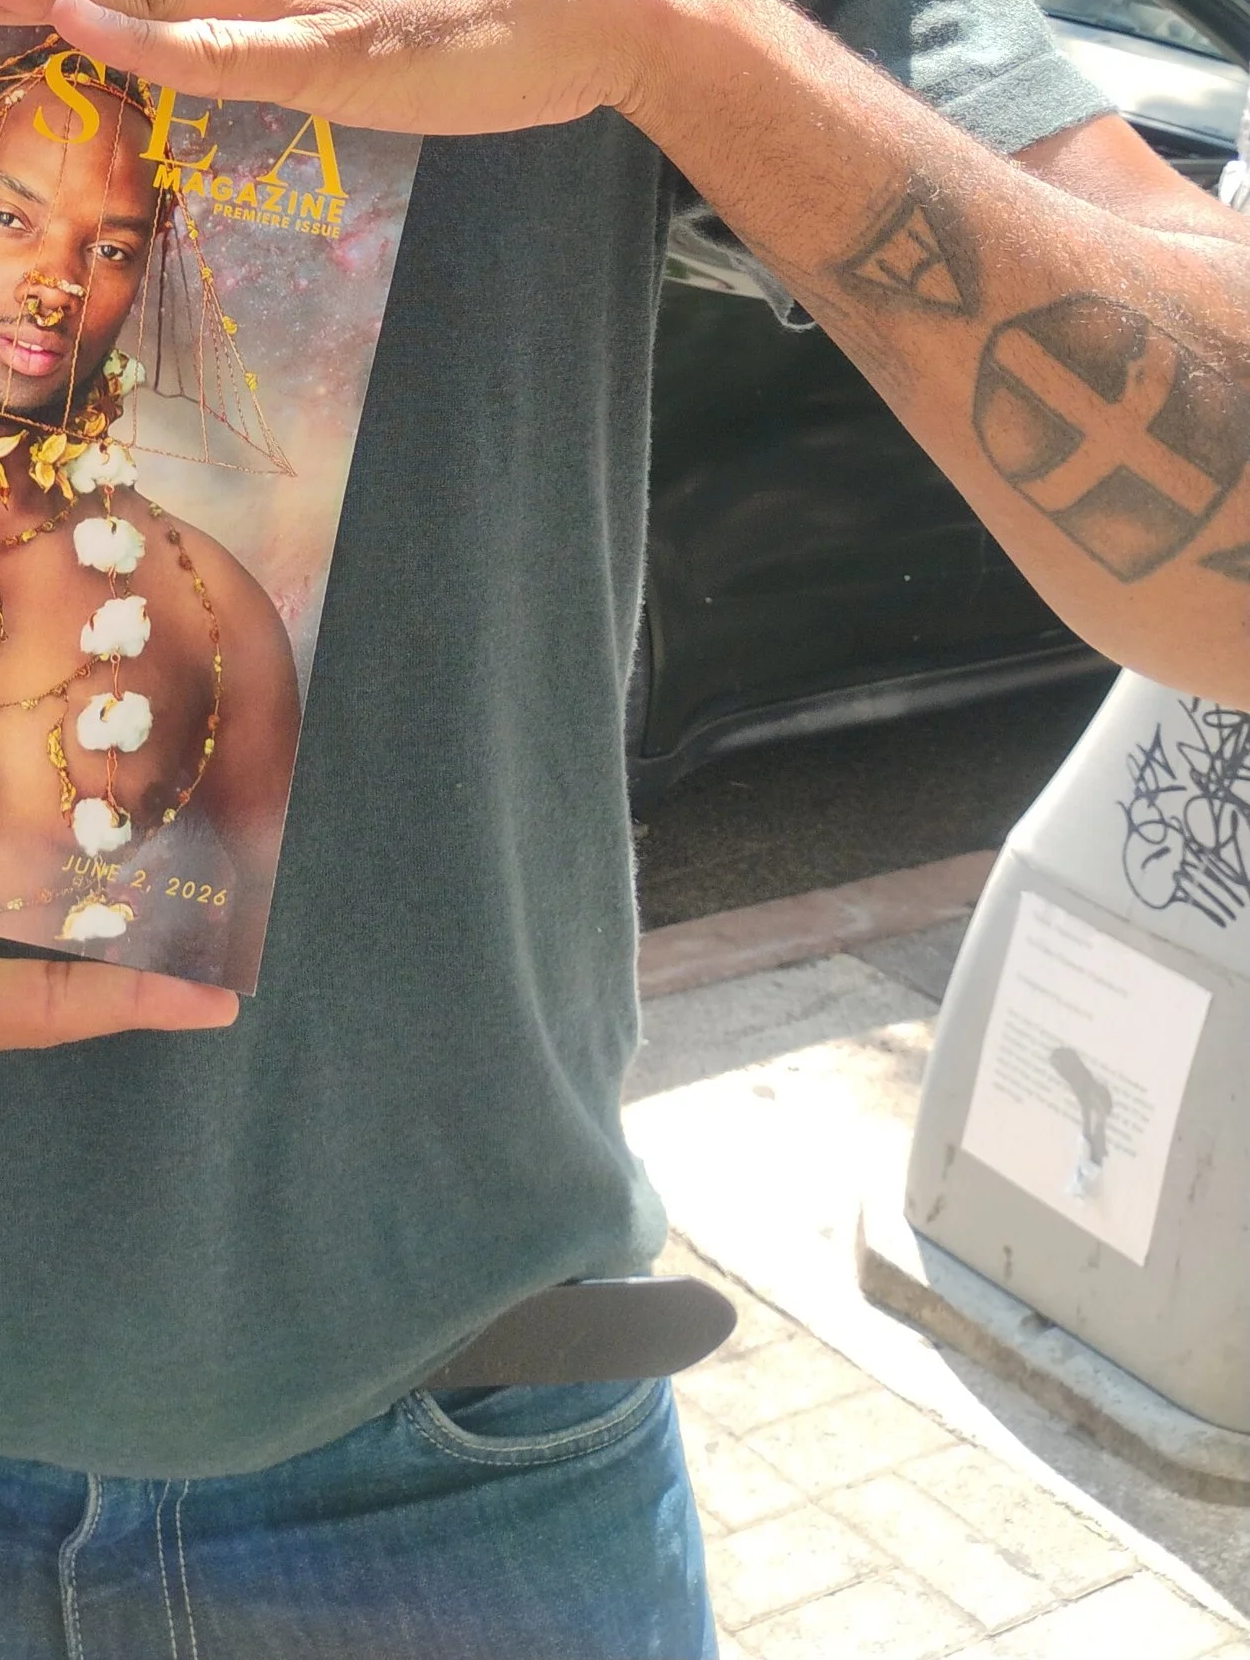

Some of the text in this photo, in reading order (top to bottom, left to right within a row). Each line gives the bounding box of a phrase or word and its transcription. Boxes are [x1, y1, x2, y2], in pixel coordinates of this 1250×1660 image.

[153, 164, 346, 224] MAGAZINE
[212, 203, 340, 239] PREMIERE ISSUE
[61, 854, 228, 907] JUNE 2, 2026
